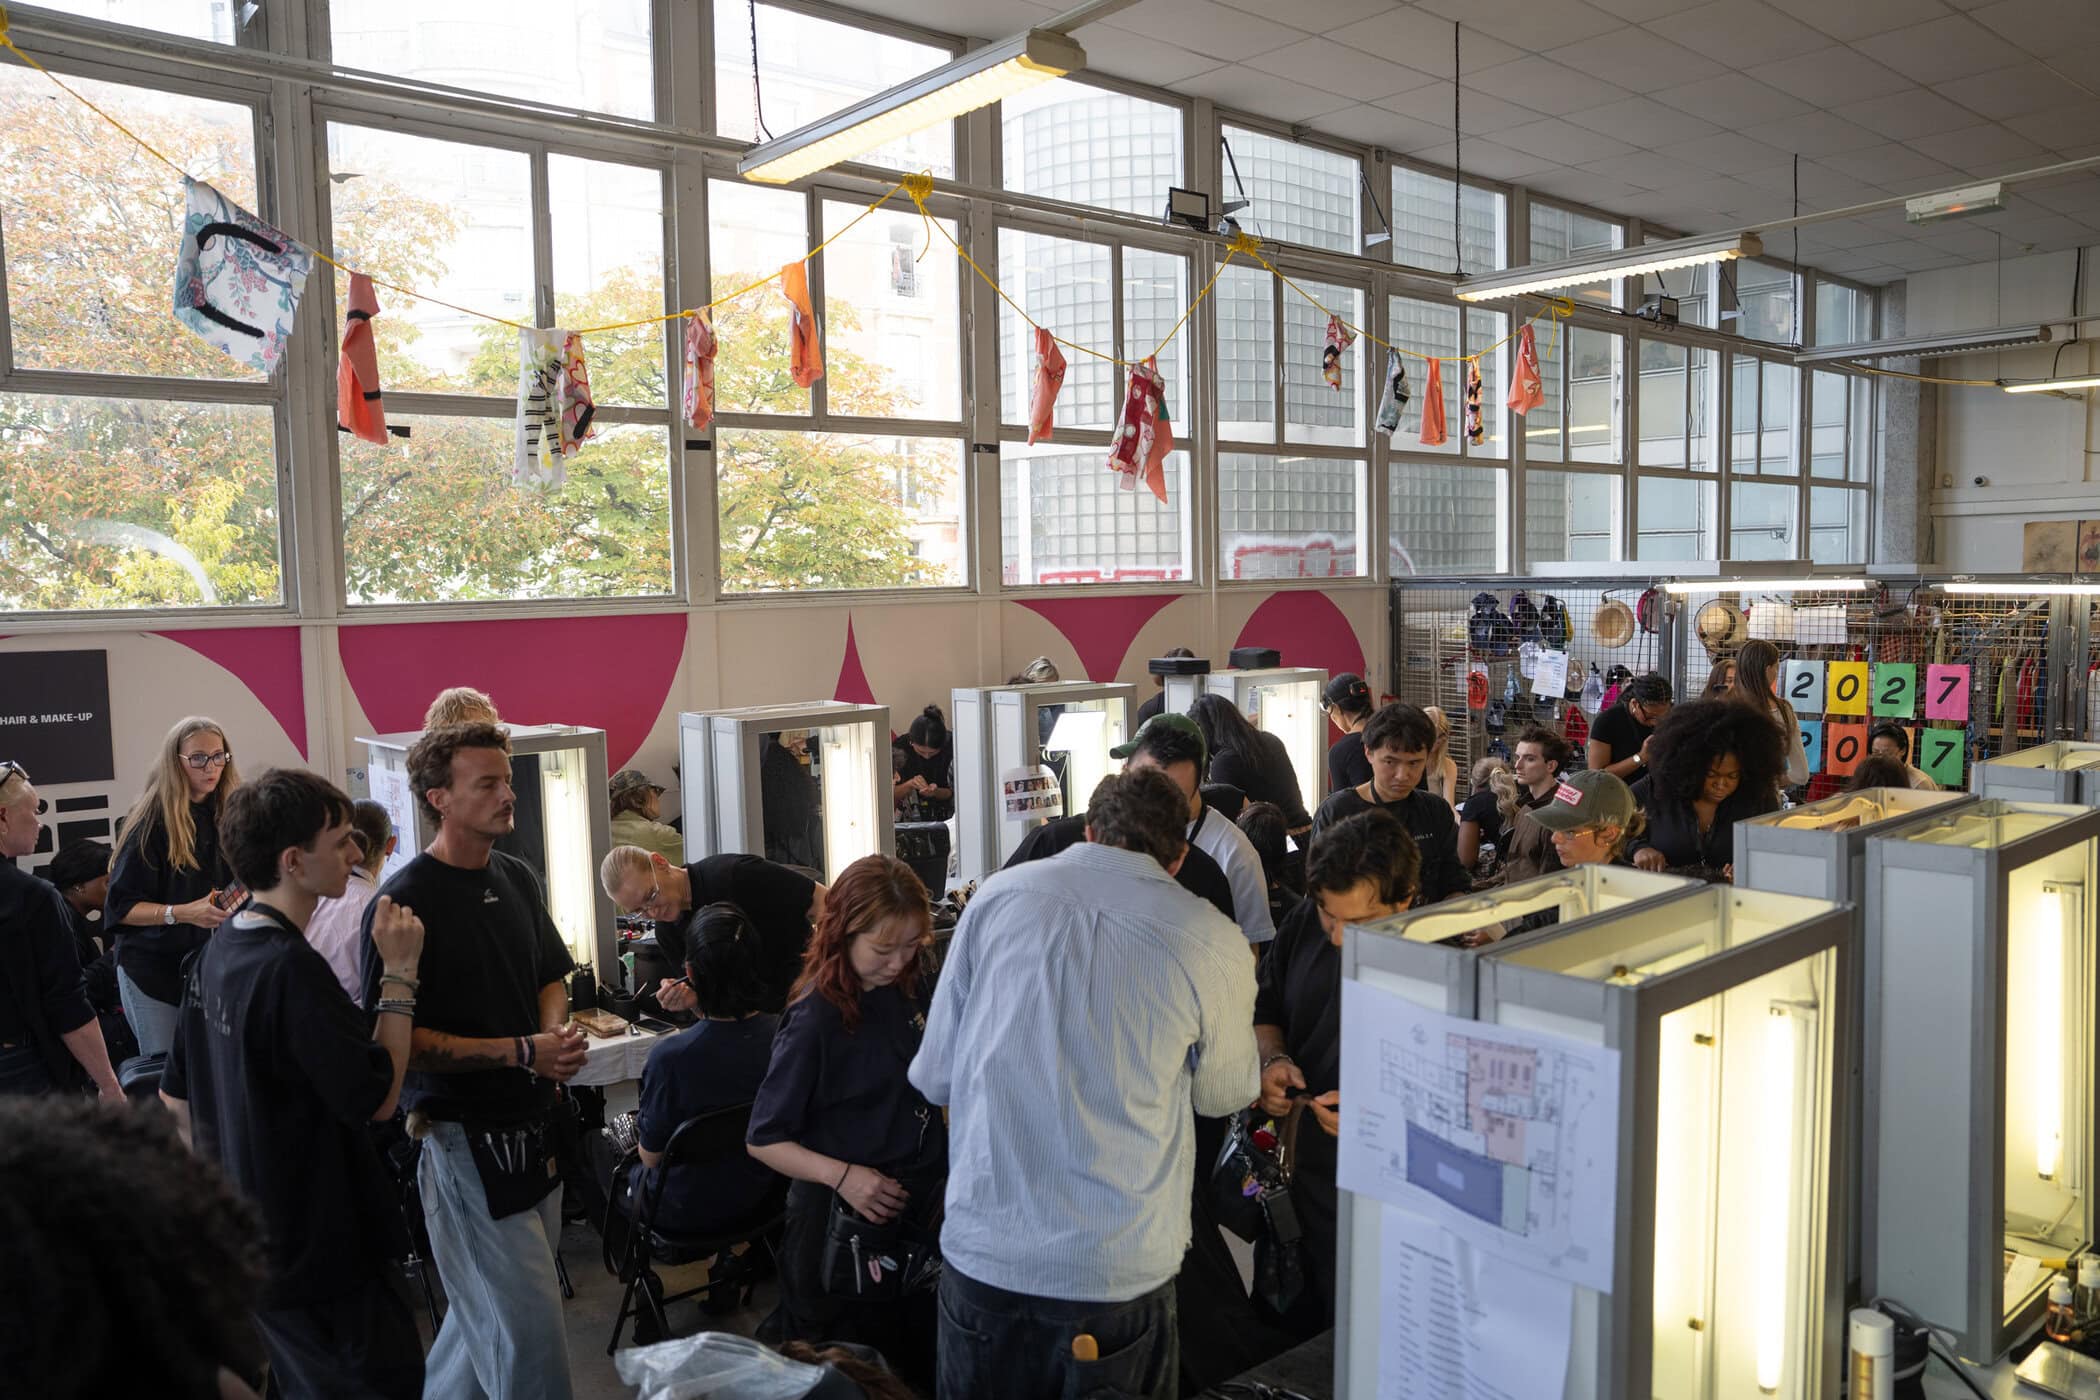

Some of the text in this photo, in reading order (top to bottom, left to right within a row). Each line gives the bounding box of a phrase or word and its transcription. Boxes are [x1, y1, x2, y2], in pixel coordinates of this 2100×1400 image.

[0, 712, 93, 725] HAIR & MAKE-UP
